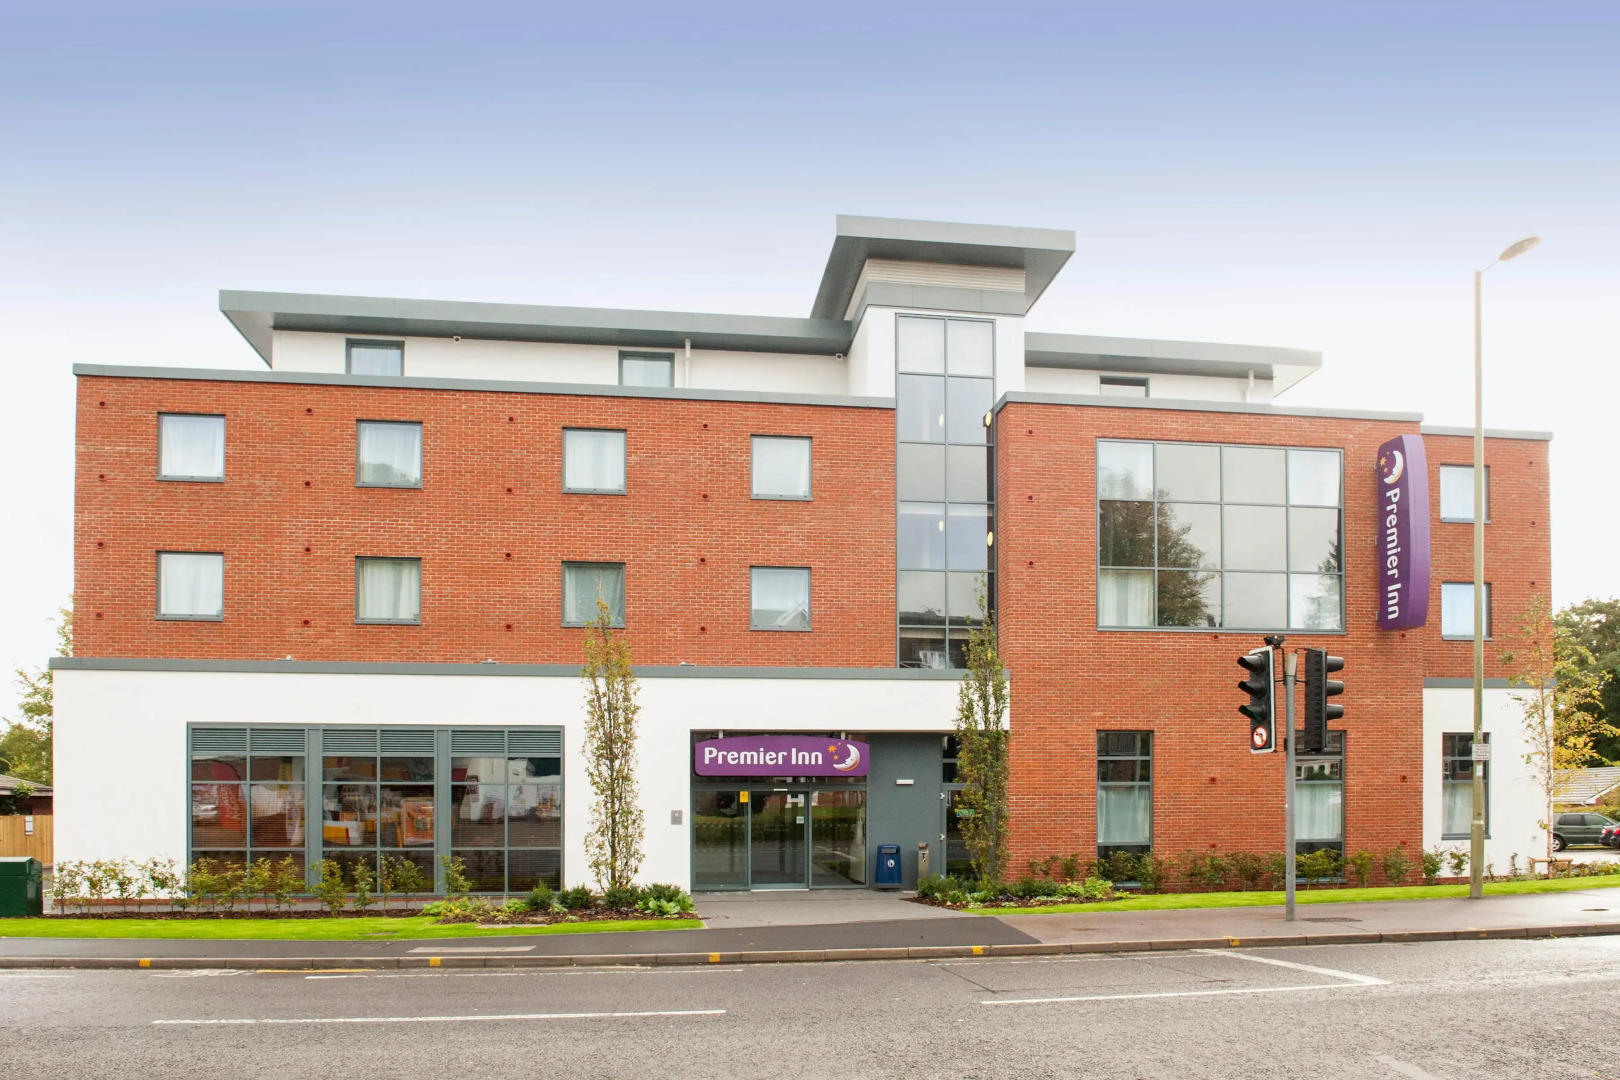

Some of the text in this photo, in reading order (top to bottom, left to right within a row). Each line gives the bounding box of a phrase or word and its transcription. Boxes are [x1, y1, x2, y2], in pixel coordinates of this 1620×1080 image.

[1386, 487, 1402, 620] Premier Inn
[704, 747, 823, 765] Premier Inn
